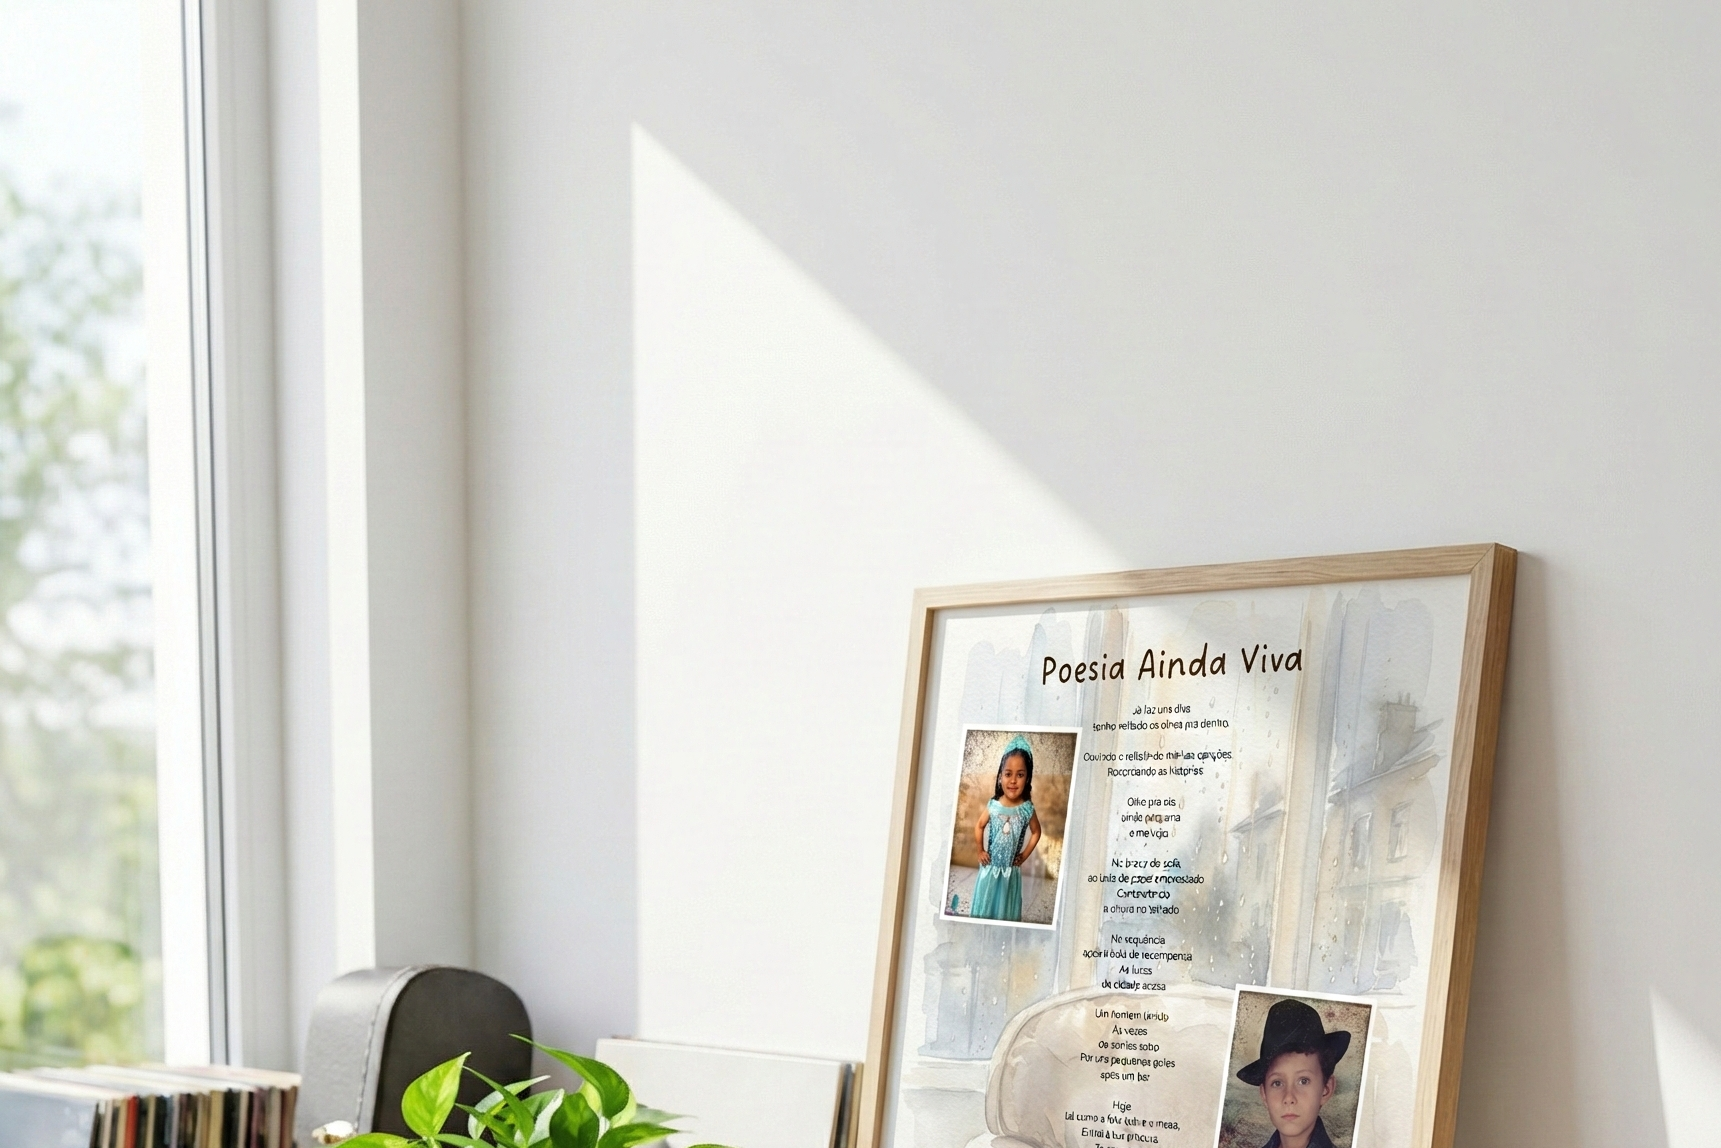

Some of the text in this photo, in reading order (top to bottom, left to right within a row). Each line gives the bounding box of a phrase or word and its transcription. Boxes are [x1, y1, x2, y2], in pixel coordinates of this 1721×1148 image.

[1043, 643, 1302, 685] Poesia Ainda Viva
[1129, 950, 1139, 959] de
